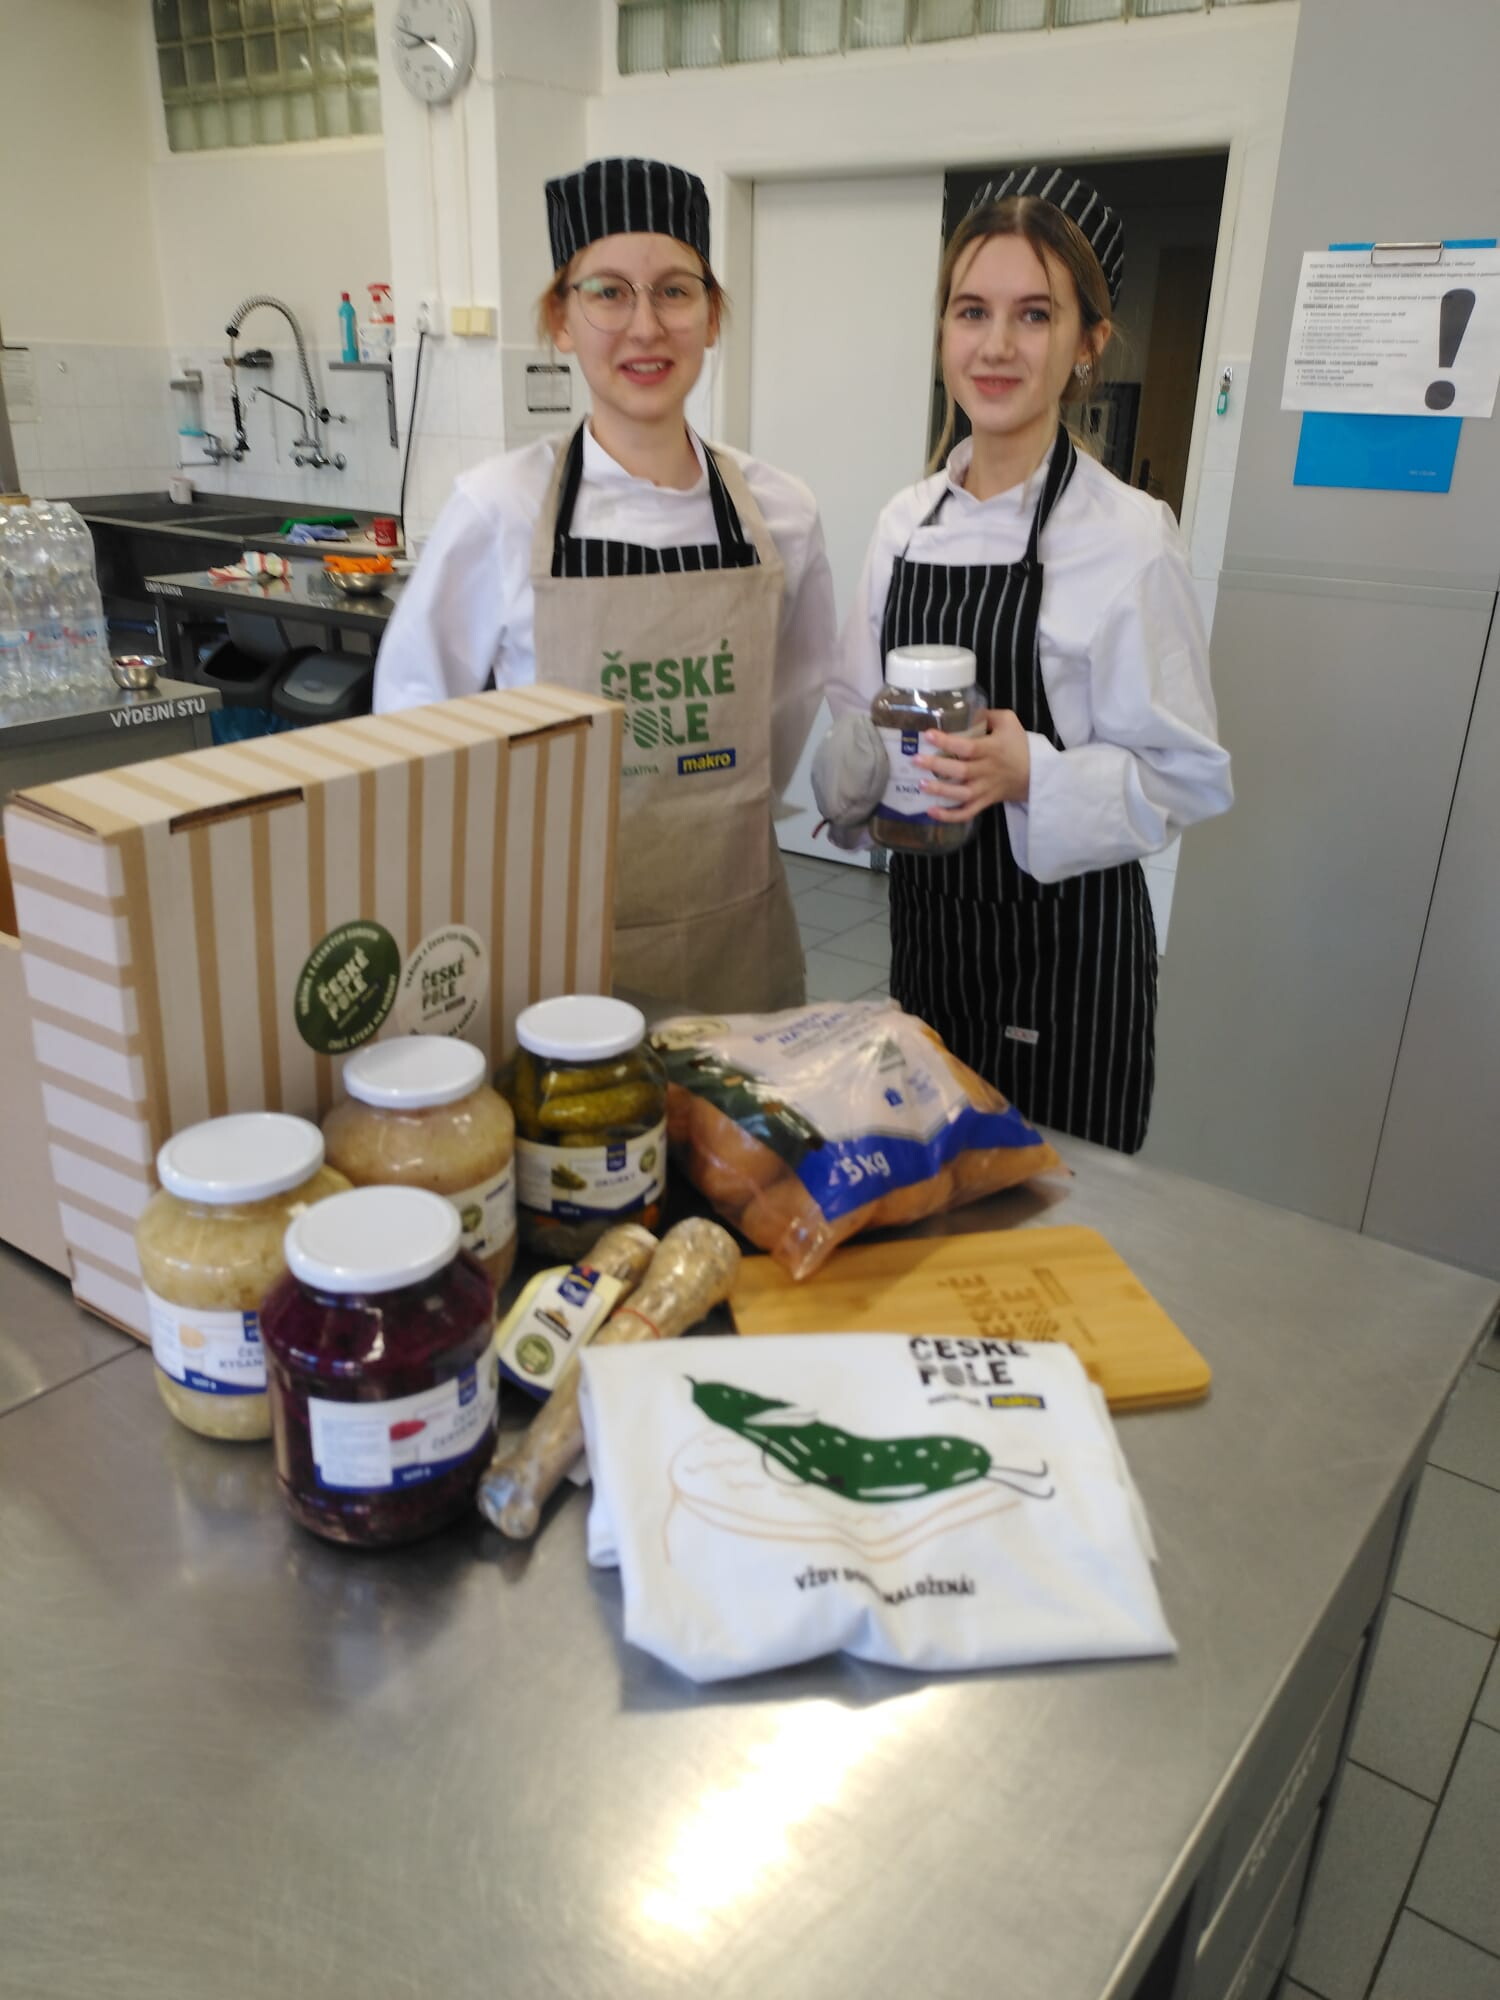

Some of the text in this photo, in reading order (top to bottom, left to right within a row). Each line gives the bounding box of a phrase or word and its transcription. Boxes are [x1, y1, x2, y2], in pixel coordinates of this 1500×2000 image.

[601, 638, 736, 702] ČESKÉ
[623, 702, 710, 748] OLE
[681, 752, 732, 773] makro
[918, 1361, 1015, 1387] POLE
